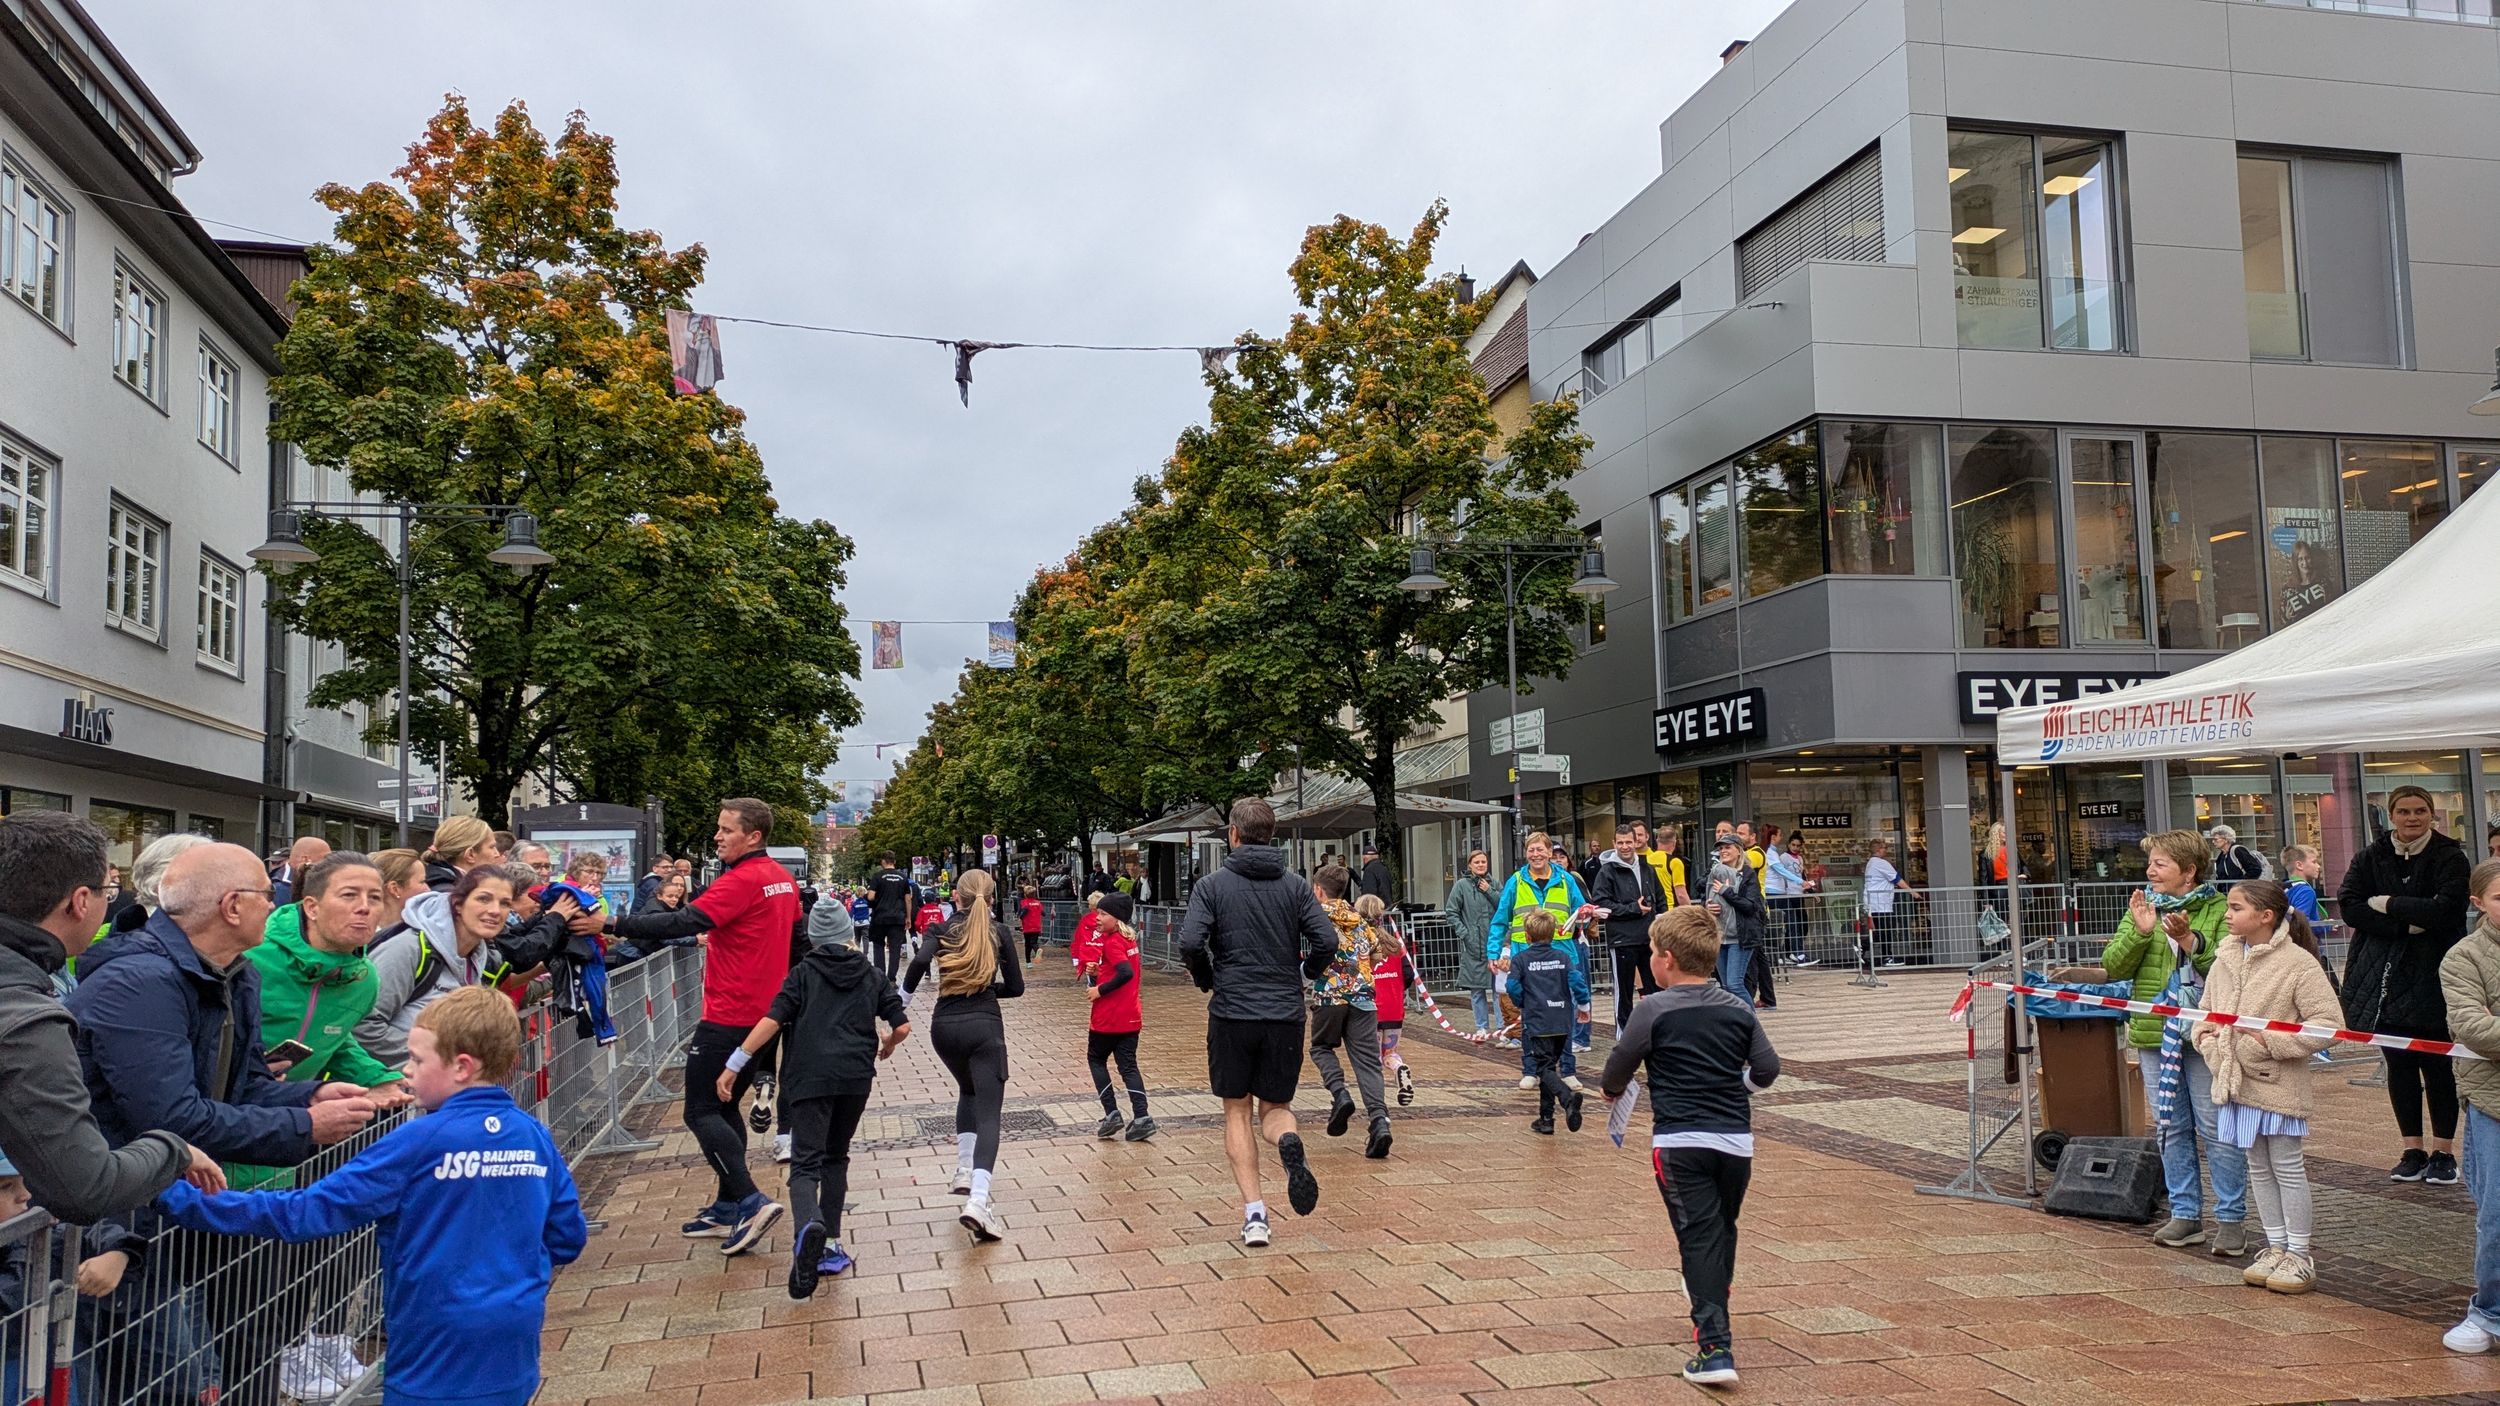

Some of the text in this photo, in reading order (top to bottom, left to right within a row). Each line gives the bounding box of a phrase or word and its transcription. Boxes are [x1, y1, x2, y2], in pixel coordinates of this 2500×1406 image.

[1967, 286, 2039, 297] ZAHNARZTRAXIS
[2286, 519, 2317, 527] EYE EYE
[2289, 584, 2324, 612] EYE
[1970, 678, 2061, 714] EYE
[69, 699, 114, 745] HAAS
[1655, 696, 1753, 746] EYE EYE
[2066, 691, 2257, 735] LEICHTATHLETIK
[2065, 721, 2253, 752] BADEN-WÜRTTEMBERG
[2081, 804, 2119, 815] EYE EYE
[1802, 816, 1848, 826] EYE EYE
[1527, 961, 1541, 971] JSG
[434, 1150, 481, 1180] JSG
[482, 1149, 536, 1163] BALINGEN
[481, 1163, 548, 1178] WEILSTETTEN
